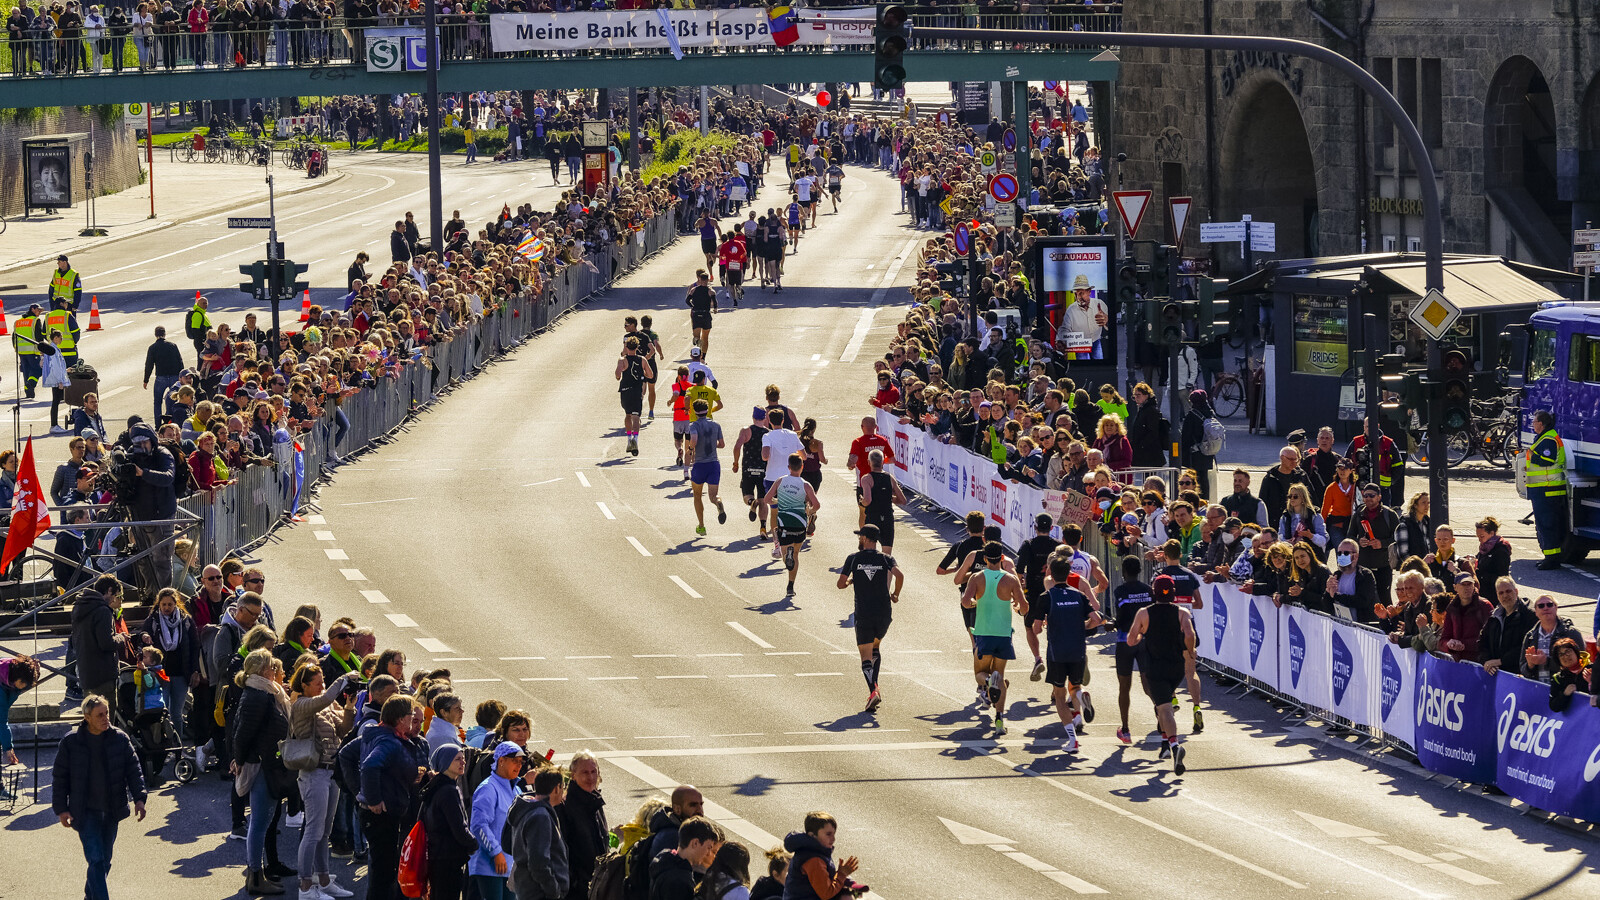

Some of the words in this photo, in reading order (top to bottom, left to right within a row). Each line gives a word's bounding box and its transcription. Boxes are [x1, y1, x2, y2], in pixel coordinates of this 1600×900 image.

[516, 23, 579, 40] Meine
[587, 21, 637, 39] Bank
[373, 42, 394, 67] S
[984, 155, 993, 164] H
[1369, 197, 1425, 216] BLOCKBRA
[1312, 351, 1338, 364] BRIDGE
[1067, 493, 1081, 507] DU
[1214, 613, 1225, 628] ACTIVE
[1250, 627, 1262, 643] ACTIVE
[1290, 644, 1303, 660] ACTIVE
[1333, 660, 1350, 677] ACTIVE
[1333, 675, 1345, 690] CITY
[1382, 675, 1398, 693] ACTIVE
[1382, 691, 1393, 706] CITY
[1425, 684, 1465, 732] asics
[1509, 710, 1564, 758] asics
[1423, 739, 1433, 752] sound
[1445, 746, 1461, 760] sound
[1461, 748, 1477, 765] body
[1506, 766, 1518, 779] sound
[1528, 771, 1544, 786] sound
[1543, 774, 1557, 793] body
